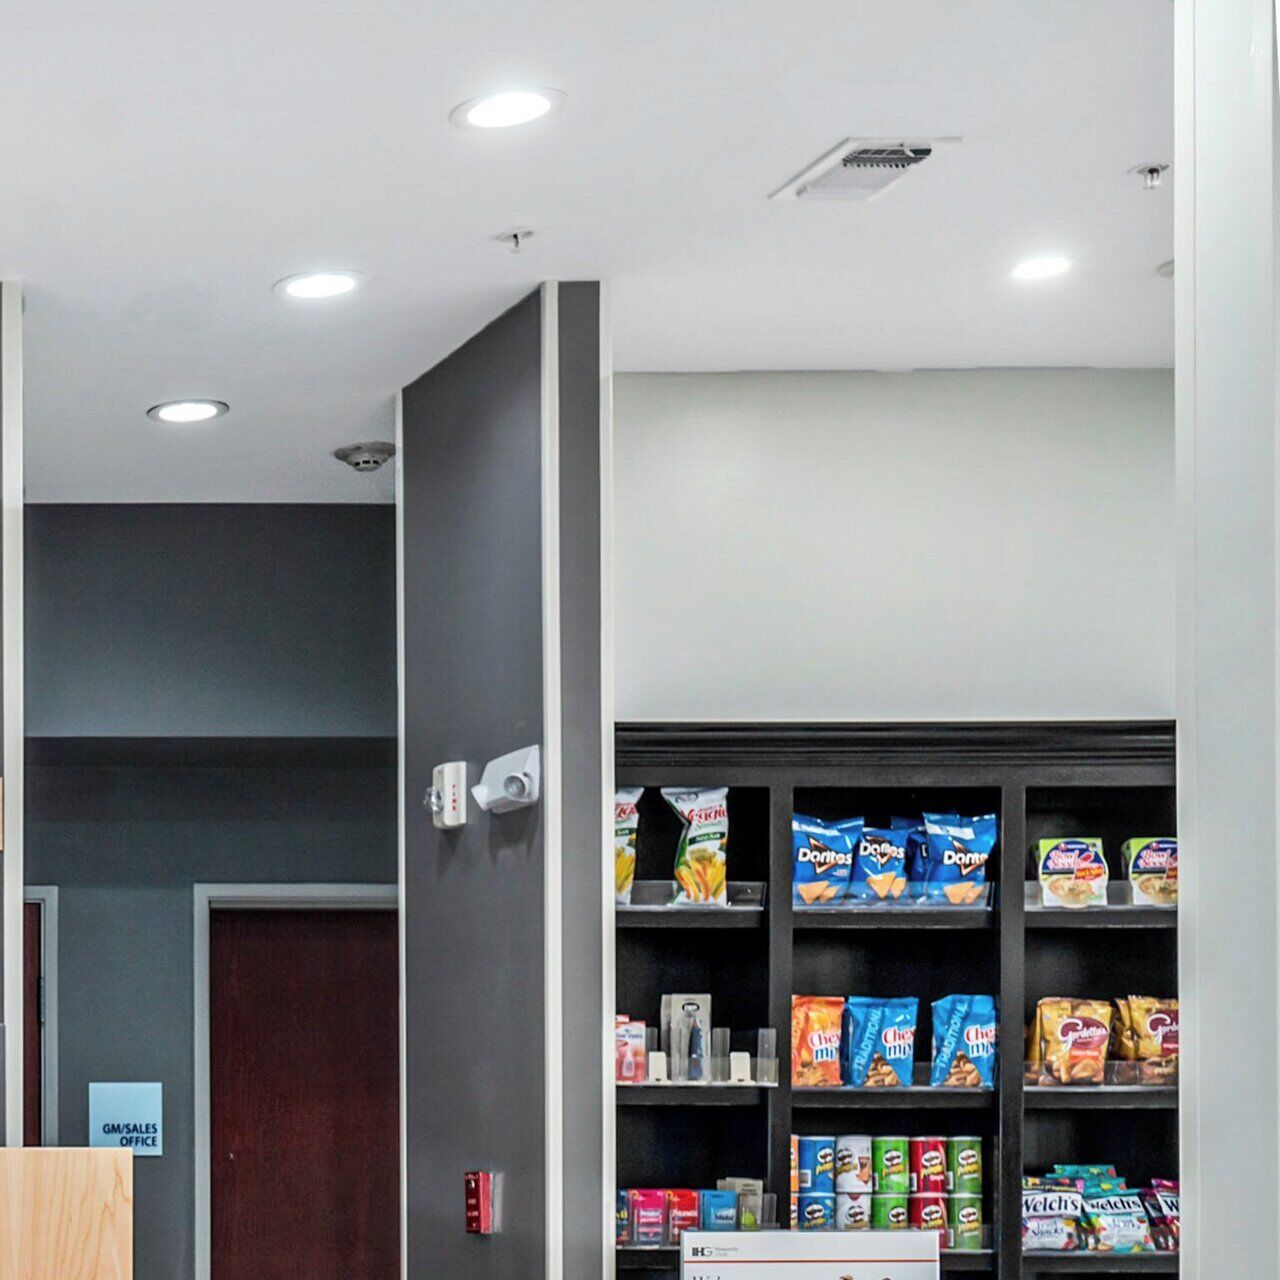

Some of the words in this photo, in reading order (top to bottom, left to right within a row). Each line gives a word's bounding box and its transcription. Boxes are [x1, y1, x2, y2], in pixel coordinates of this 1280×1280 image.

[798, 848, 853, 865] Doritos
[102, 1123, 158, 1135] GM/SALES
[120, 1136, 158, 1147] OFFICE
[692, 1247, 713, 1257] IHG
